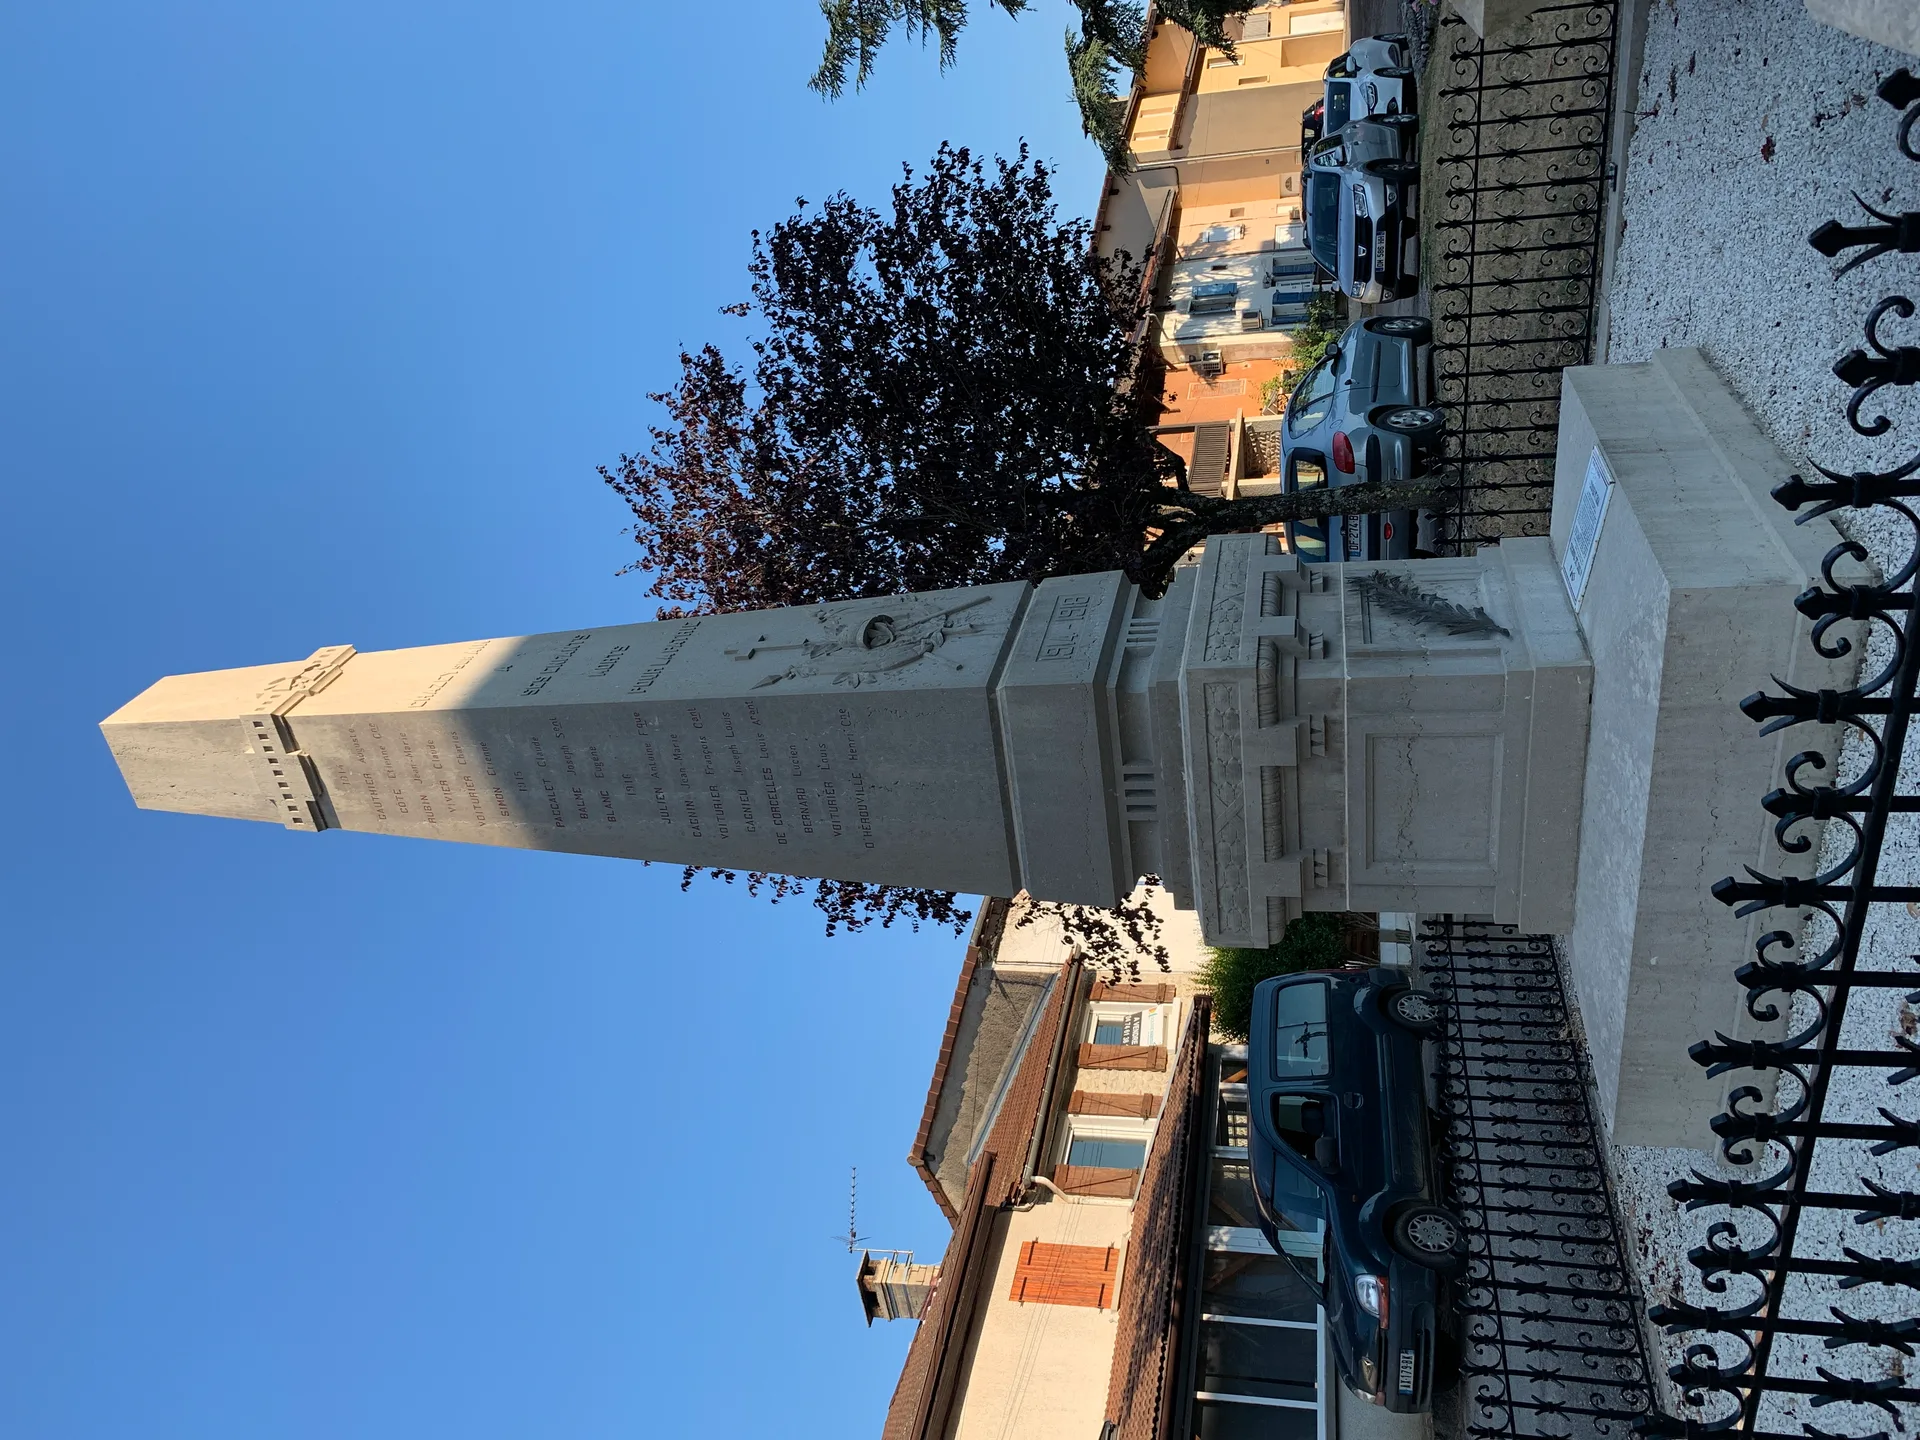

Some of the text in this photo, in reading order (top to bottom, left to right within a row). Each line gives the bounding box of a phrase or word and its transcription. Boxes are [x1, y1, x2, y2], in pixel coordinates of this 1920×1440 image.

[519, 634, 591, 696] SES ENFANTS
[587, 645, 630, 677] MORTS
[627, 621, 701, 694] POUR LA PATRIE
[408, 671, 459, 708] CHAZEY
[721, 712, 735, 738] Louis
[531, 736, 547, 768] Claude
[560, 745, 577, 776] Joseph
[644, 742, 660, 779] Antoine
[699, 735, 715, 775] François
[728, 744, 743, 776] Joseph
[757, 732, 769, 759] Louis
[846, 733, 858, 760] Henri
[426, 739, 457, 813] VIVIER Claude
[450, 731, 486, 827] VOITURIER Charles
[513, 771, 528, 792] 1915
[622, 773, 637, 796] 1916
[789, 744, 814, 834] BERNARD Lucien
[818, 743, 842, 837] VOITURIER Louis
[363, 773, 387, 820] GAUTHIER
[419, 794, 437, 824] RUBIN
[492, 787, 510, 817] SIMON
[571, 787, 589, 819] BALME
[600, 790, 617, 822] BLANC
[653, 786, 672, 824] JULIEN
[708, 785, 729, 840] VOITURIER
[762, 767, 783, 826] CORCELLES
[776, 832, 788, 845] DE
[1131, 1021, 1140, 1045] VENDRE
